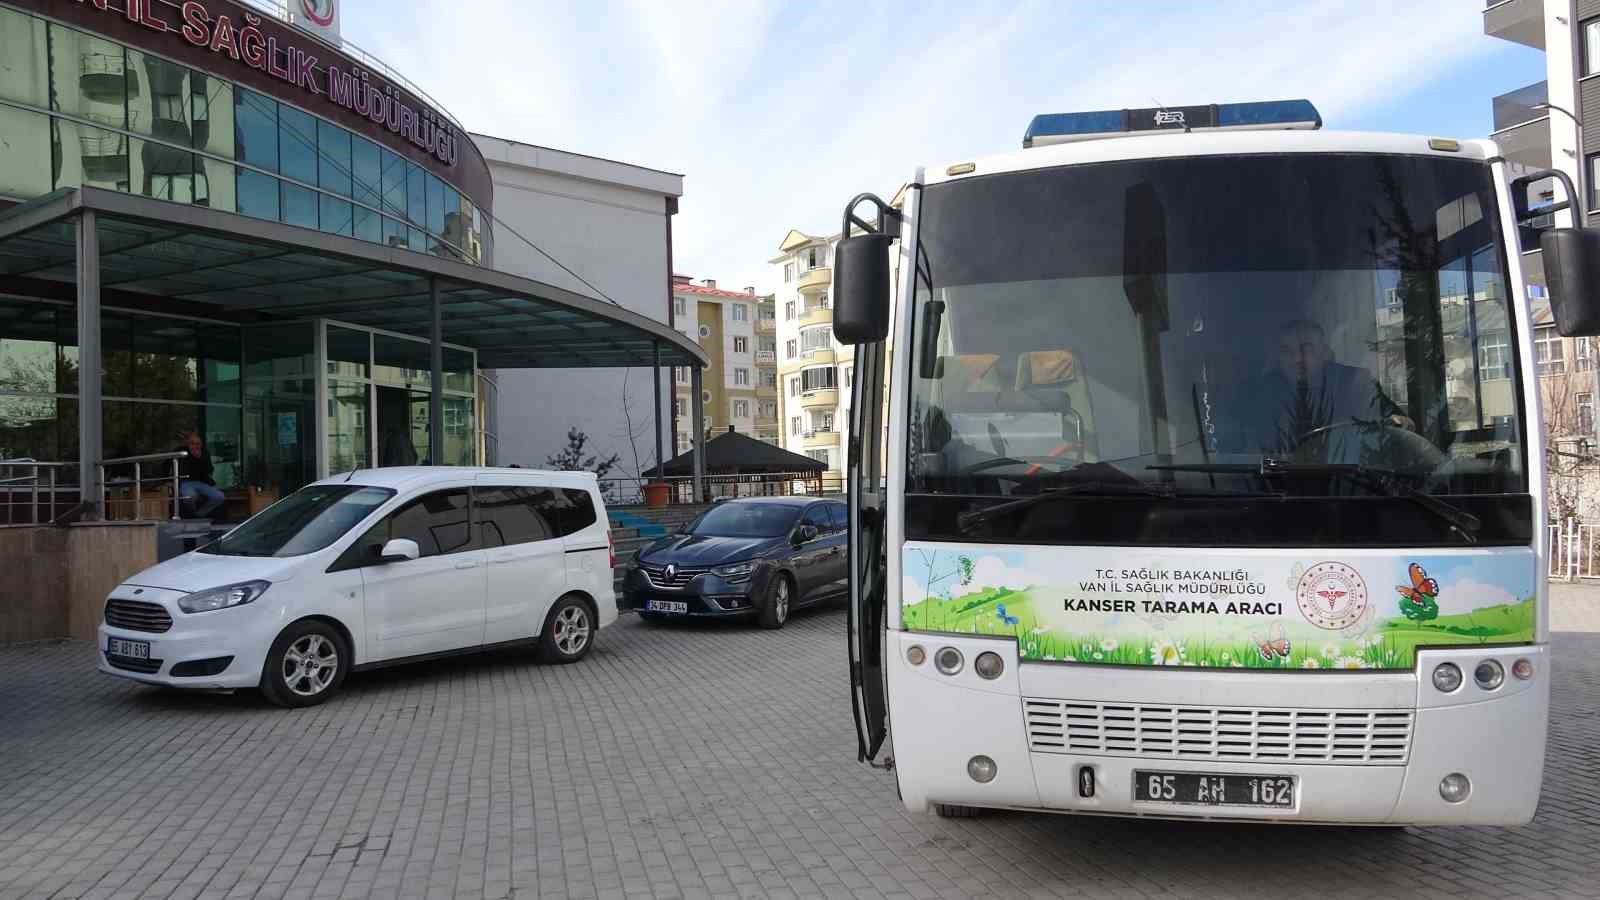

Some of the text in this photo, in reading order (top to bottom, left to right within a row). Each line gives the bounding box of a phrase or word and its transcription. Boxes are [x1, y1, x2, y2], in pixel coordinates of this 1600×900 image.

[182, 1, 319, 94] SAĞLIK
[329, 65, 458, 168] MÜDÜRLÜĞÜ
[1095, 569, 1117, 579] T.C.
[1121, 568, 1168, 580] SAĞLIK
[1080, 581, 1266, 595] VAN İL SAĞLIK MÜDÜRLÜĞÜ
[1064, 599, 1282, 615] KANSER TARAMA ARACI
[1148, 775, 1290, 805] 65 AH 162
